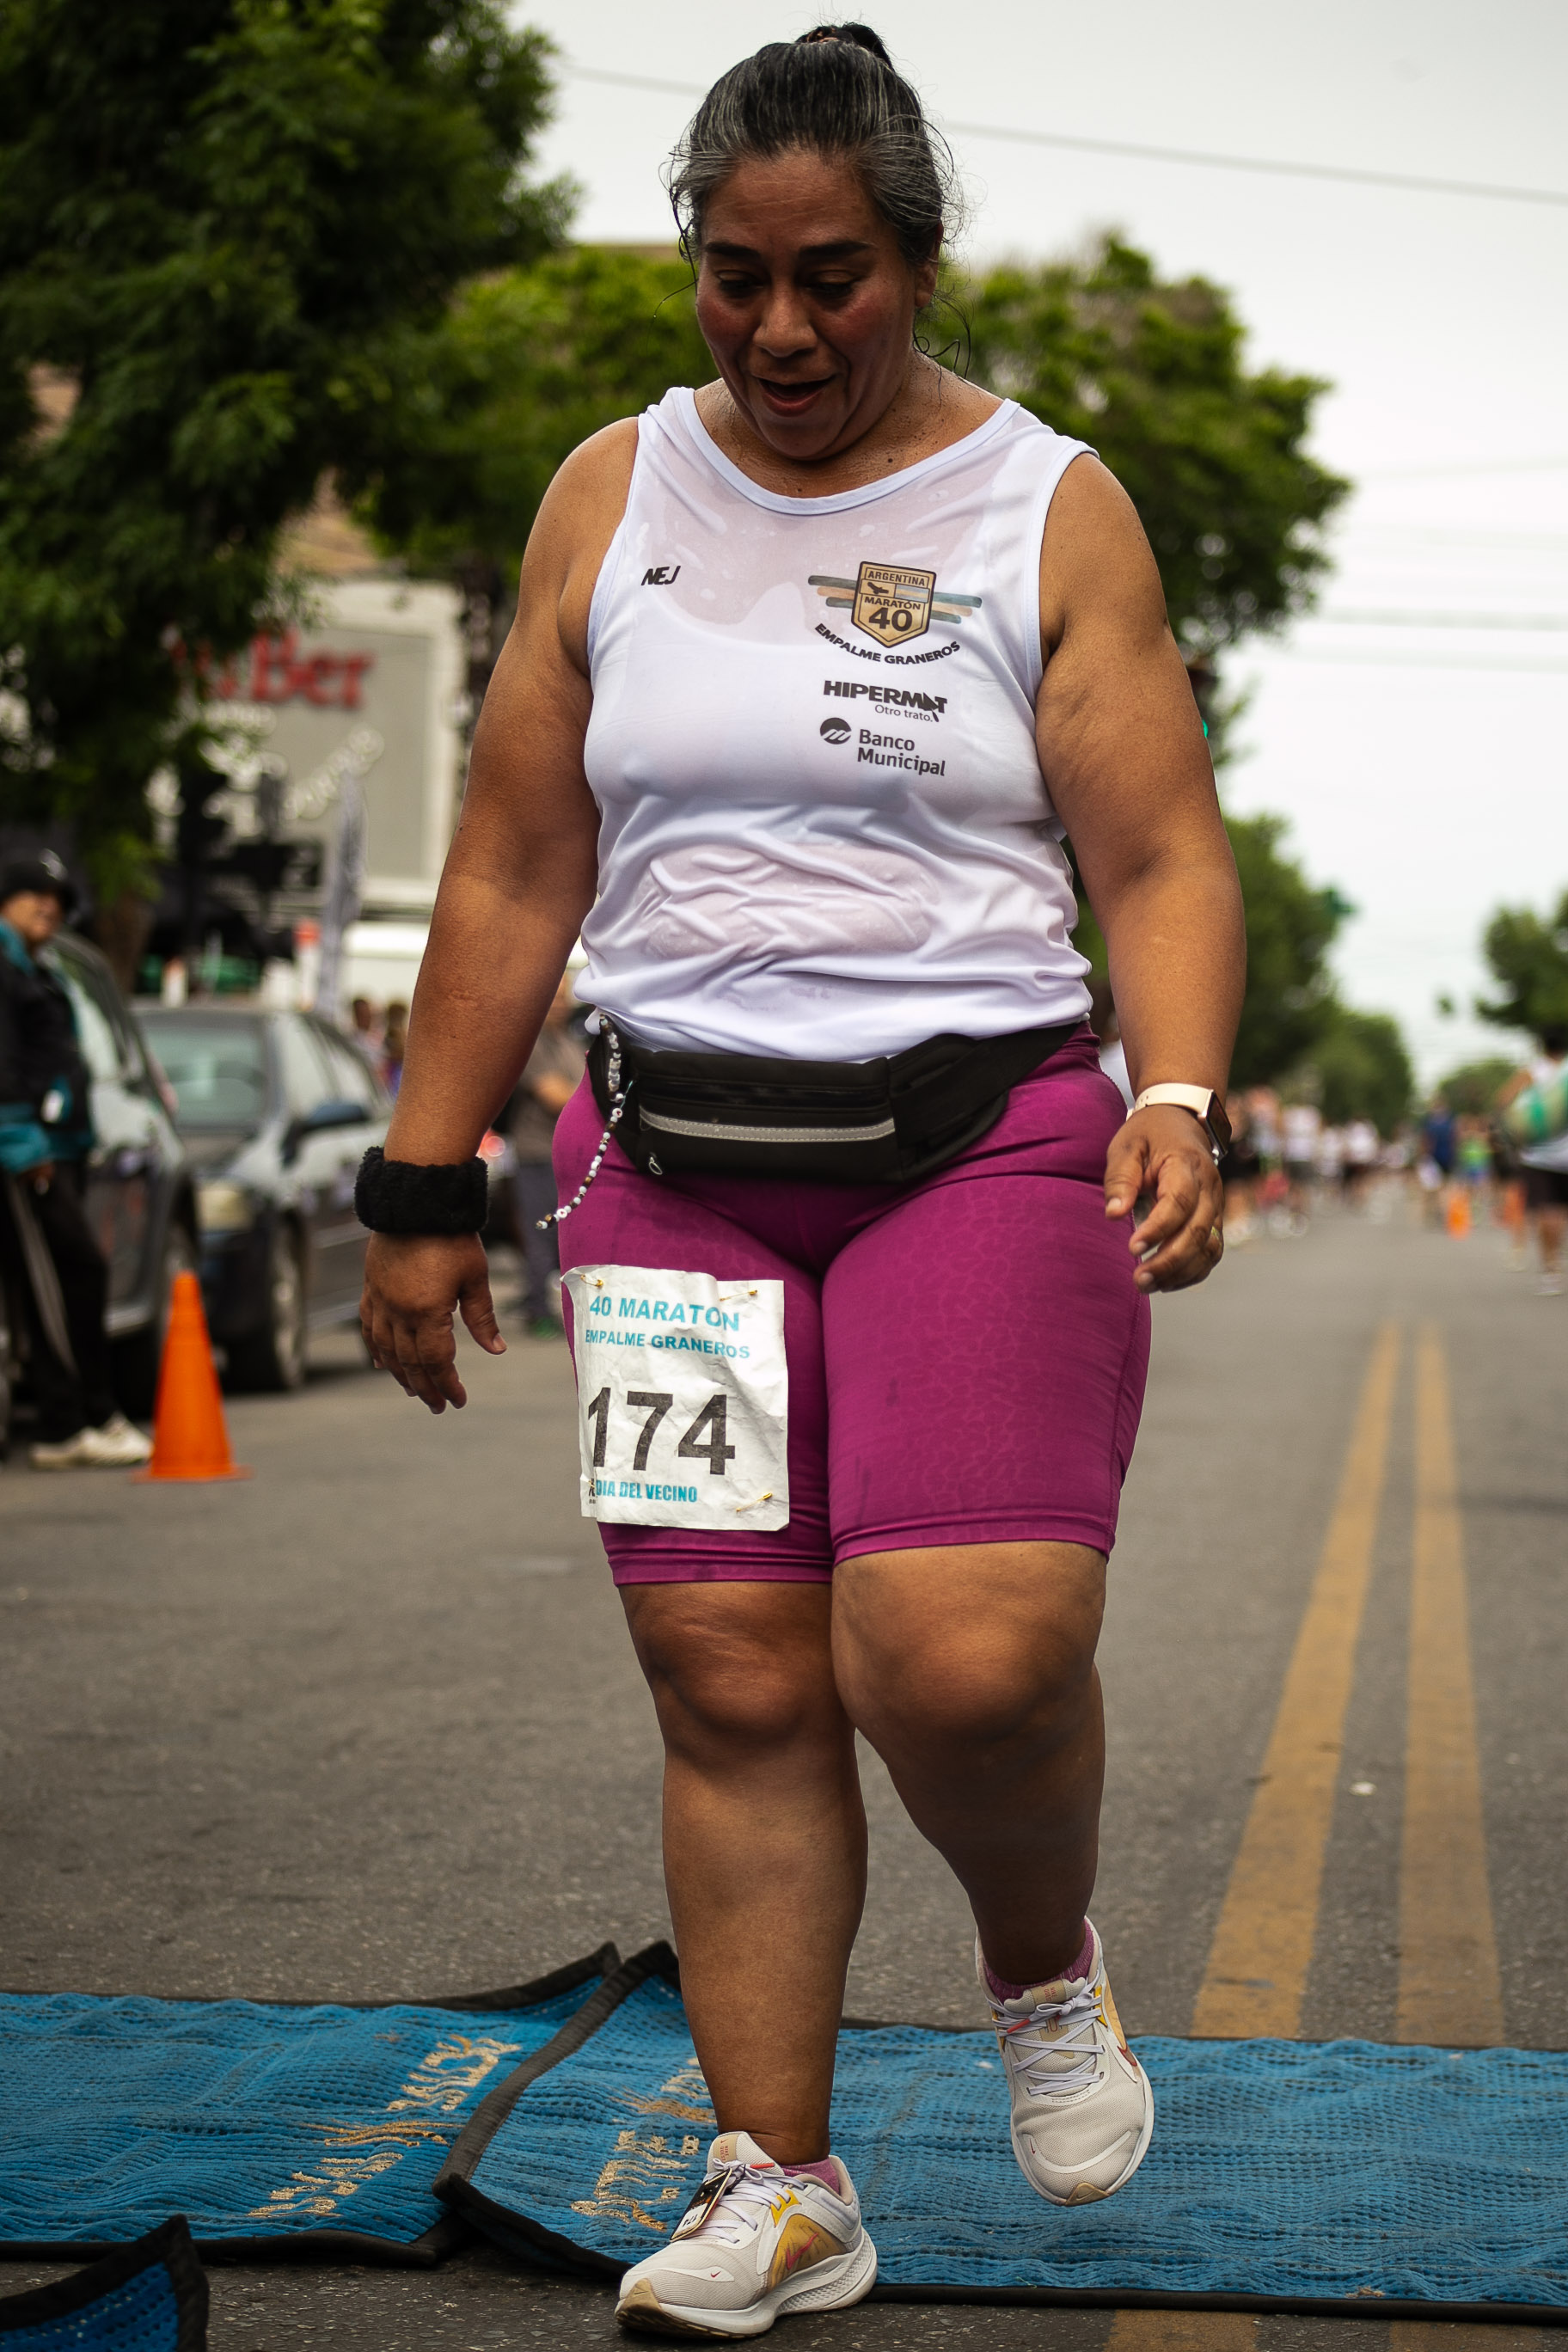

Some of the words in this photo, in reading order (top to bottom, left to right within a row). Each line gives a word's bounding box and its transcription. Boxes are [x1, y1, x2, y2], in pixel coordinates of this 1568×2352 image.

[867, 570, 926, 587] ARGENTINA
[868, 607, 913, 632] 40
[814, 622, 882, 662] EMPALME
[884, 640, 961, 665] GRANEROS
[875, 704, 902, 717] Otro
[904, 709, 934, 722] trato.
[860, 728, 916, 751] Banco
[857, 746, 946, 776] Municipal
[590, 1296, 612, 1317] 40
[618, 1297, 740, 1332] MARATON
[585, 1329, 645, 1348] EMPALME
[651, 1334, 750, 1359] GRANEROS
[588, 1387, 736, 1476] 174
[596, 1479, 616, 1497] DIA
[619, 1481, 642, 1499] DEL
[646, 1484, 698, 1503] VECINO
